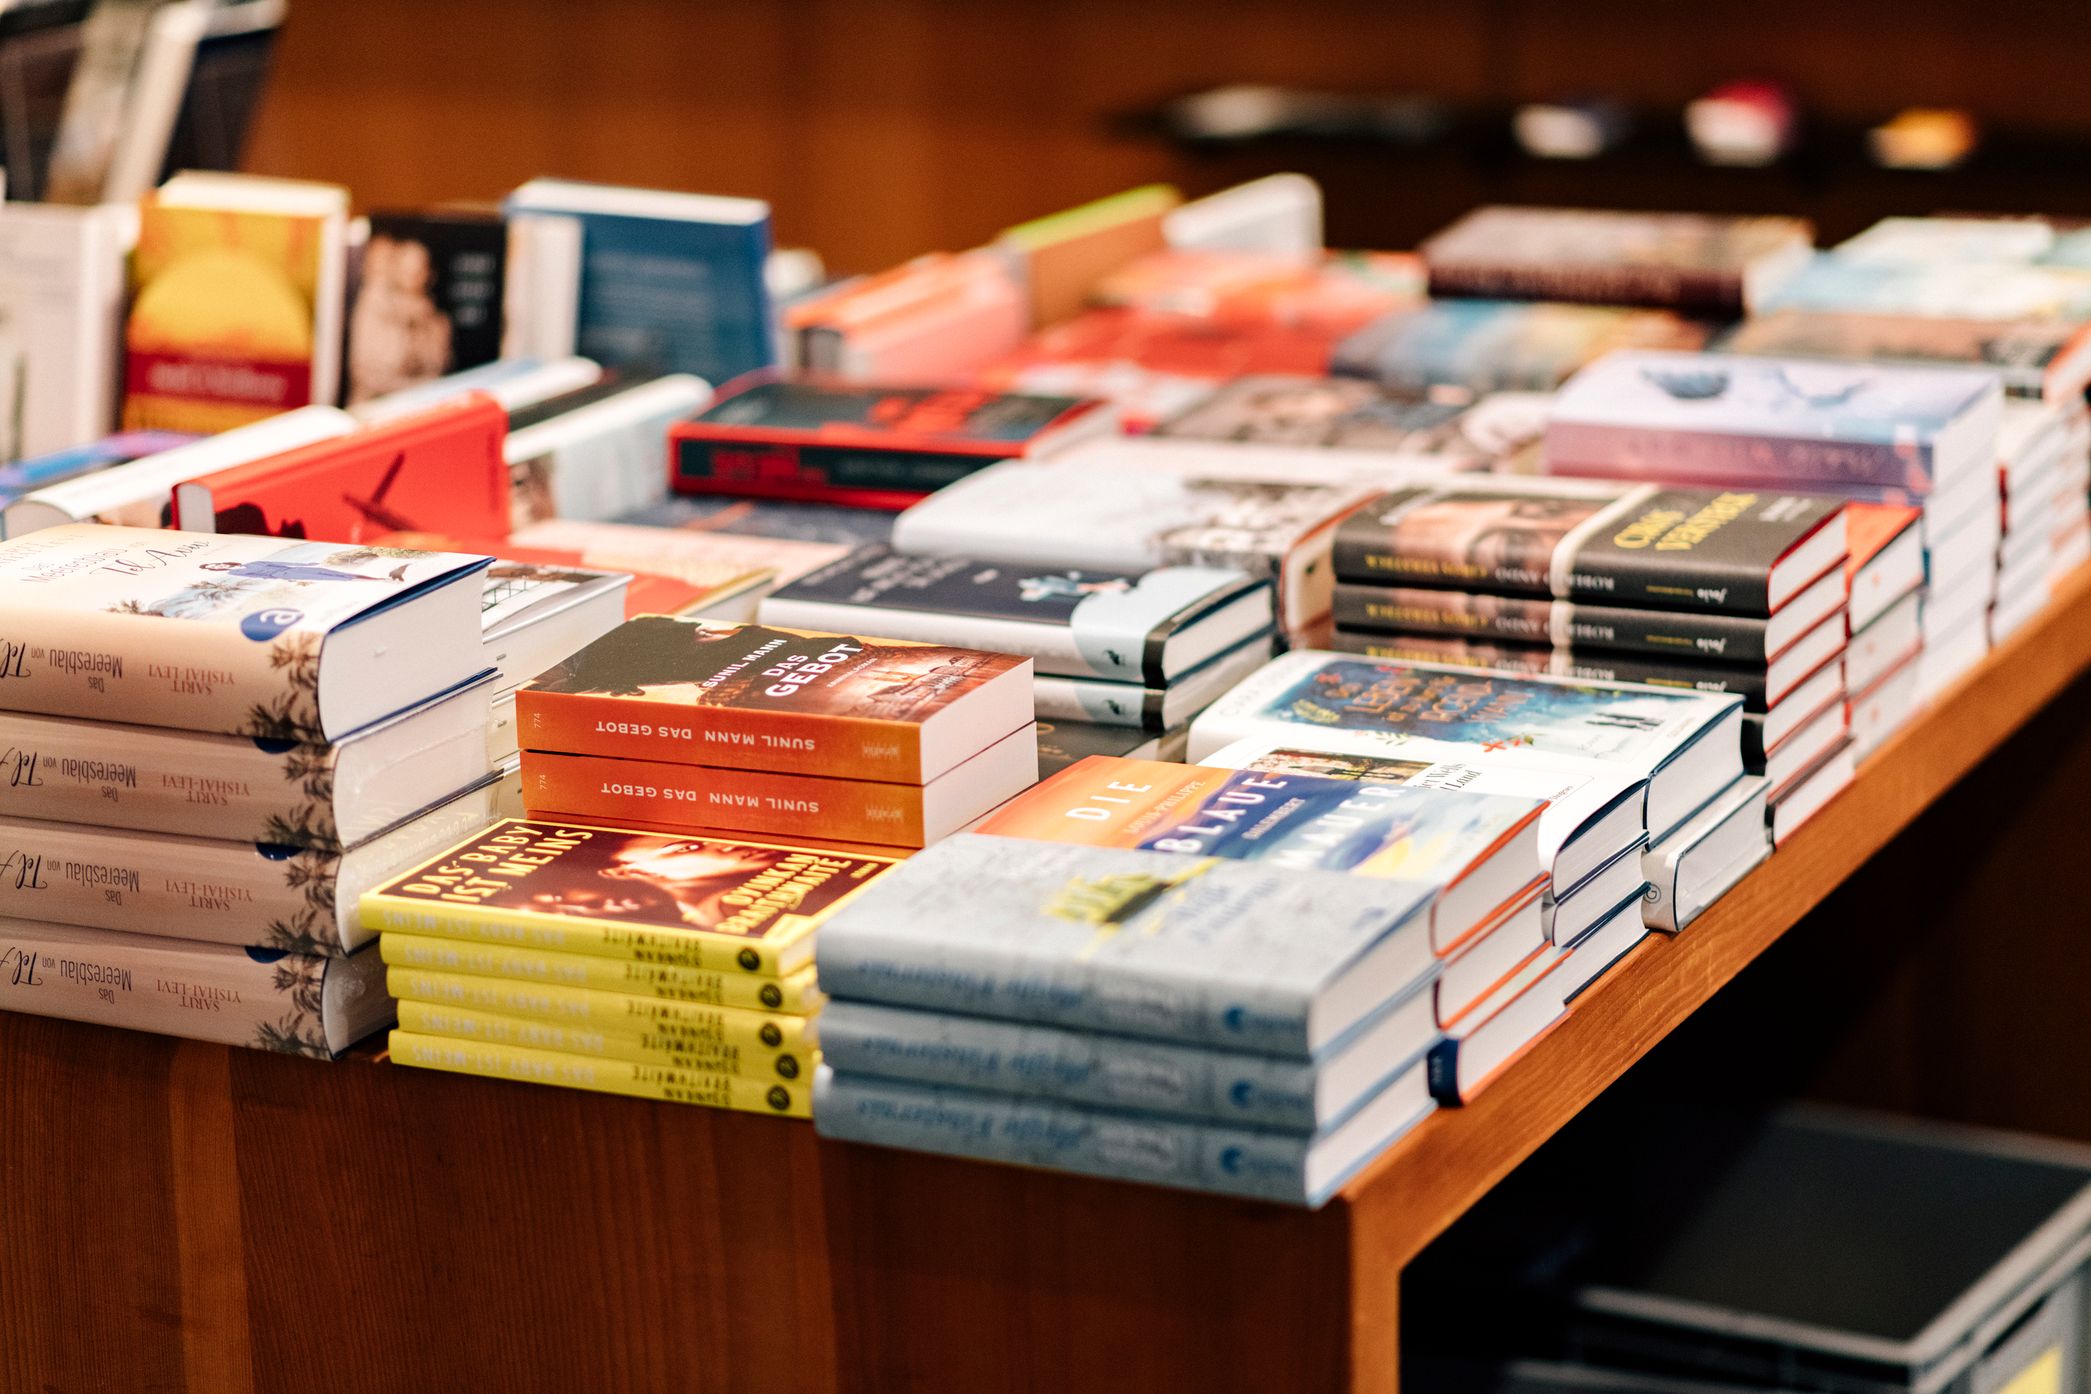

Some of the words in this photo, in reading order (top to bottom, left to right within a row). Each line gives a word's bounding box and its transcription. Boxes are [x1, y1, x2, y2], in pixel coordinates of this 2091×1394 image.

[89, 559, 151, 576] Tel
[31, 647, 45, 659] von
[50, 649, 122, 678] Meeresblau
[702, 661, 749, 688] SUNIL
[747, 639, 788, 661] MANN
[762, 655, 809, 676] DAS
[765, 643, 863, 697] GEBOT
[149, 664, 235, 685] YISHAI-LEVI
[88, 677, 104, 692] Das
[173, 680, 212, 695] SARIT
[534, 712, 542, 729] 774
[595, 721, 652, 736] GEBOT
[659, 727, 692, 740] DAS
[705, 730, 755, 745] MANN
[761, 735, 815, 750] SUNIL
[11, 751, 43, 787] Tel
[43, 756, 57, 768] von
[62, 758, 136, 788] Meeresblau
[102, 786, 118, 802] Das
[163, 774, 250, 797] YISHAI-LEVI
[601, 783, 657, 798] GEBOT
[185, 791, 228, 806] SARIT
[664, 788, 696, 802] DAS
[709, 792, 759, 807] MANN
[1065, 780, 1152, 821] DIE
[766, 798, 819, 813] SUNIL
[1154, 778, 1287, 853] BLAUE
[1269, 786, 1406, 870] MAUER
[47, 859, 60, 871] von
[403, 864, 474, 894] DAS
[460, 826, 543, 862] BABY
[441, 876, 509, 902] IST
[488, 829, 593, 876] MEINS
[15, 853, 48, 889] Tel
[66, 861, 139, 893] Meeresblau
[105, 890, 121, 905] Das
[166, 880, 253, 902] YISHAI-LEVI
[188, 896, 230, 911] SARIT
[12, 951, 43, 985] Tel
[42, 956, 55, 968] von
[61, 959, 132, 991] Meeresblau
[99, 988, 115, 1004] Das
[157, 979, 241, 1003] YISHAI-LEVI
[179, 996, 220, 1012] SARIT
